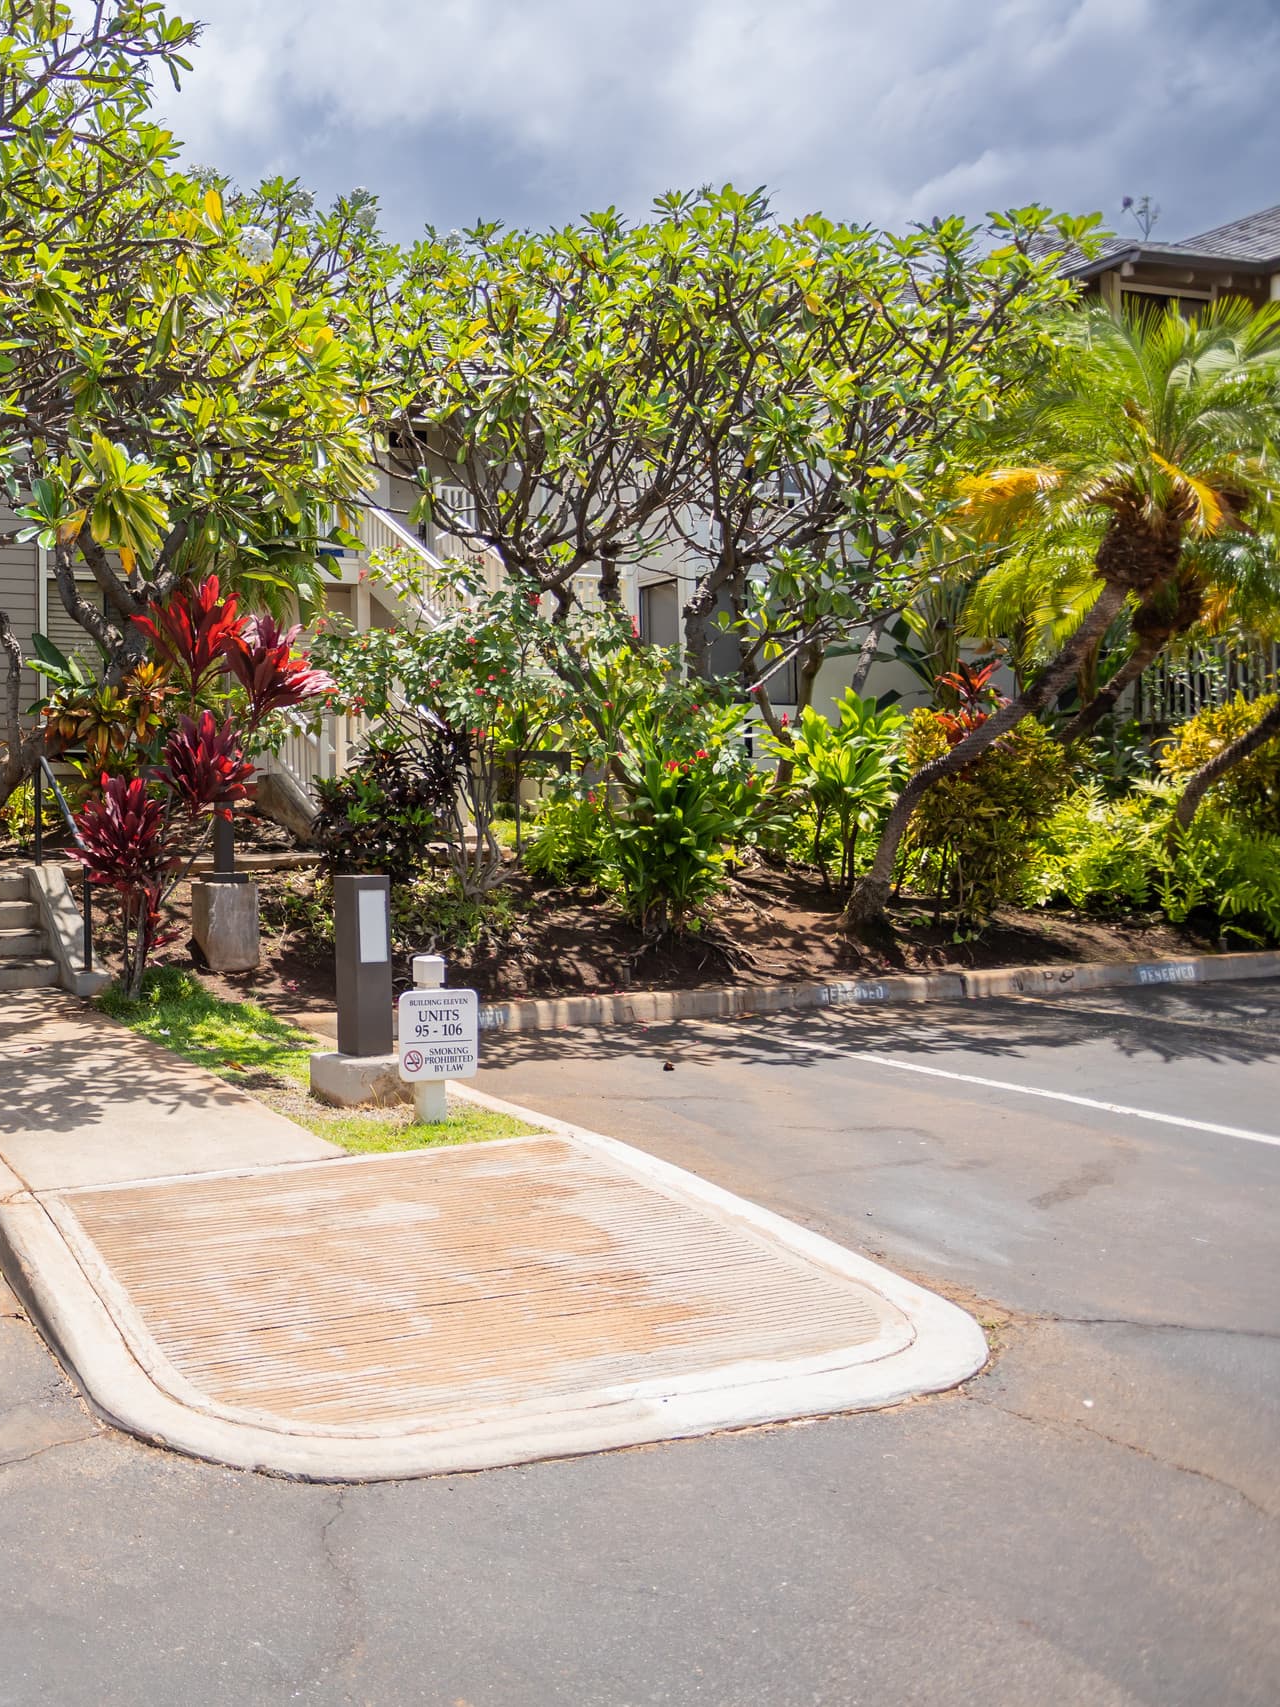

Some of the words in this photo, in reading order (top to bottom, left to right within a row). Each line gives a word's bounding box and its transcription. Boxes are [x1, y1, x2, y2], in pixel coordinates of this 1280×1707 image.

[1139, 964, 1196, 983] RESERVED
[409, 999, 442, 1007] BUILDING
[418, 1009, 460, 1022] UNITS
[415, 1024, 429, 1037] 95
[442, 1023, 463, 1036] 106
[429, 1047, 469, 1056] SMOKING
[424, 1055, 474, 1065] PROHIBITED
[434, 1064, 445, 1073] BY
[446, 1063, 464, 1072] LAW
